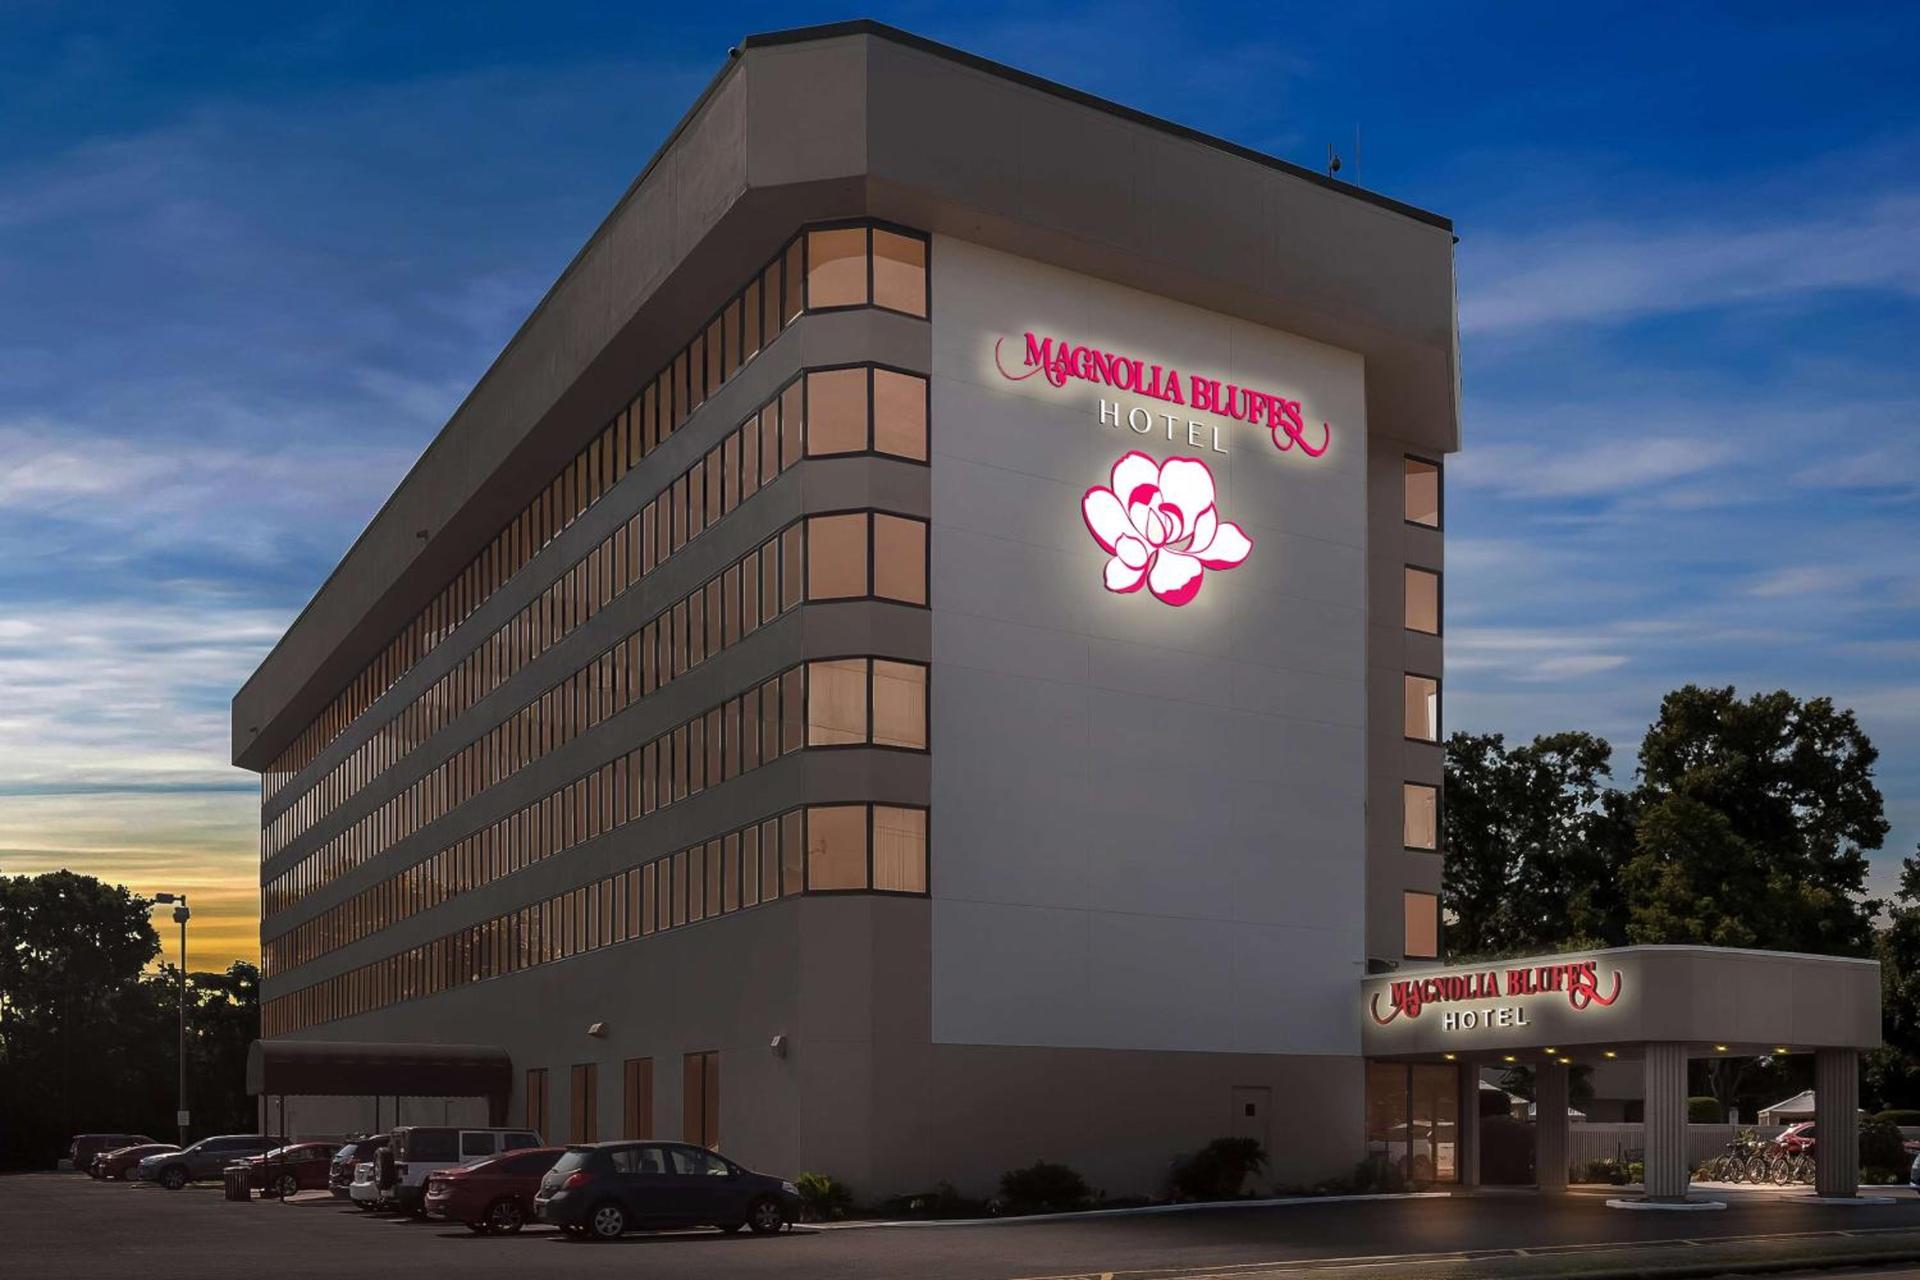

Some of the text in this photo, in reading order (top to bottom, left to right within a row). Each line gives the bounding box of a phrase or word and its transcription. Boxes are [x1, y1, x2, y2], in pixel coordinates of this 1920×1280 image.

[996, 332, 1329, 457] MAGNOLIA BLUFFS
[1100, 399, 1228, 453] HOTEL
[1371, 961, 1621, 1025] MAGNOLIA BLUFFS
[1443, 1007, 1529, 1031] HOTEL
